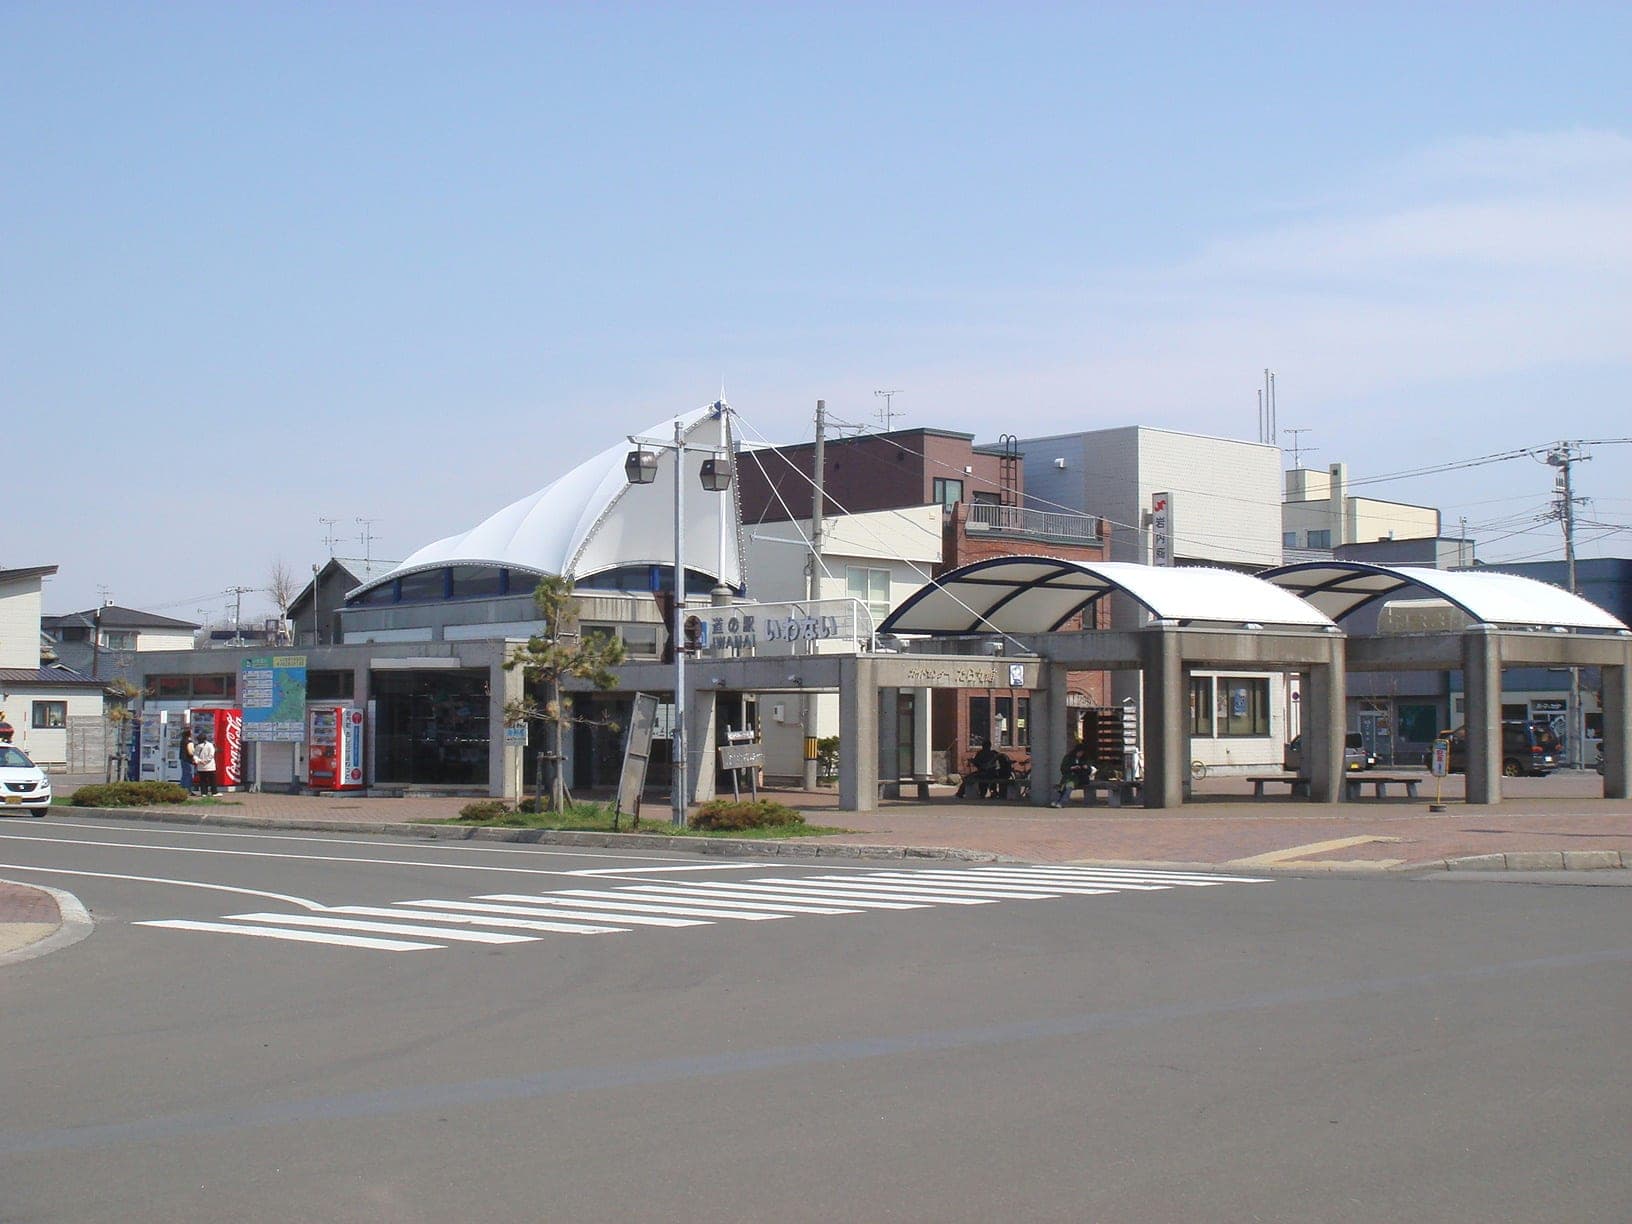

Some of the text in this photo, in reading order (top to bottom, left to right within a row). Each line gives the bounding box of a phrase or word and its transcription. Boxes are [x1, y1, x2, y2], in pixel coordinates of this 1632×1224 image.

[712, 615, 838, 642] 道の駅 いわない
[712, 633, 756, 650] IWANAI
